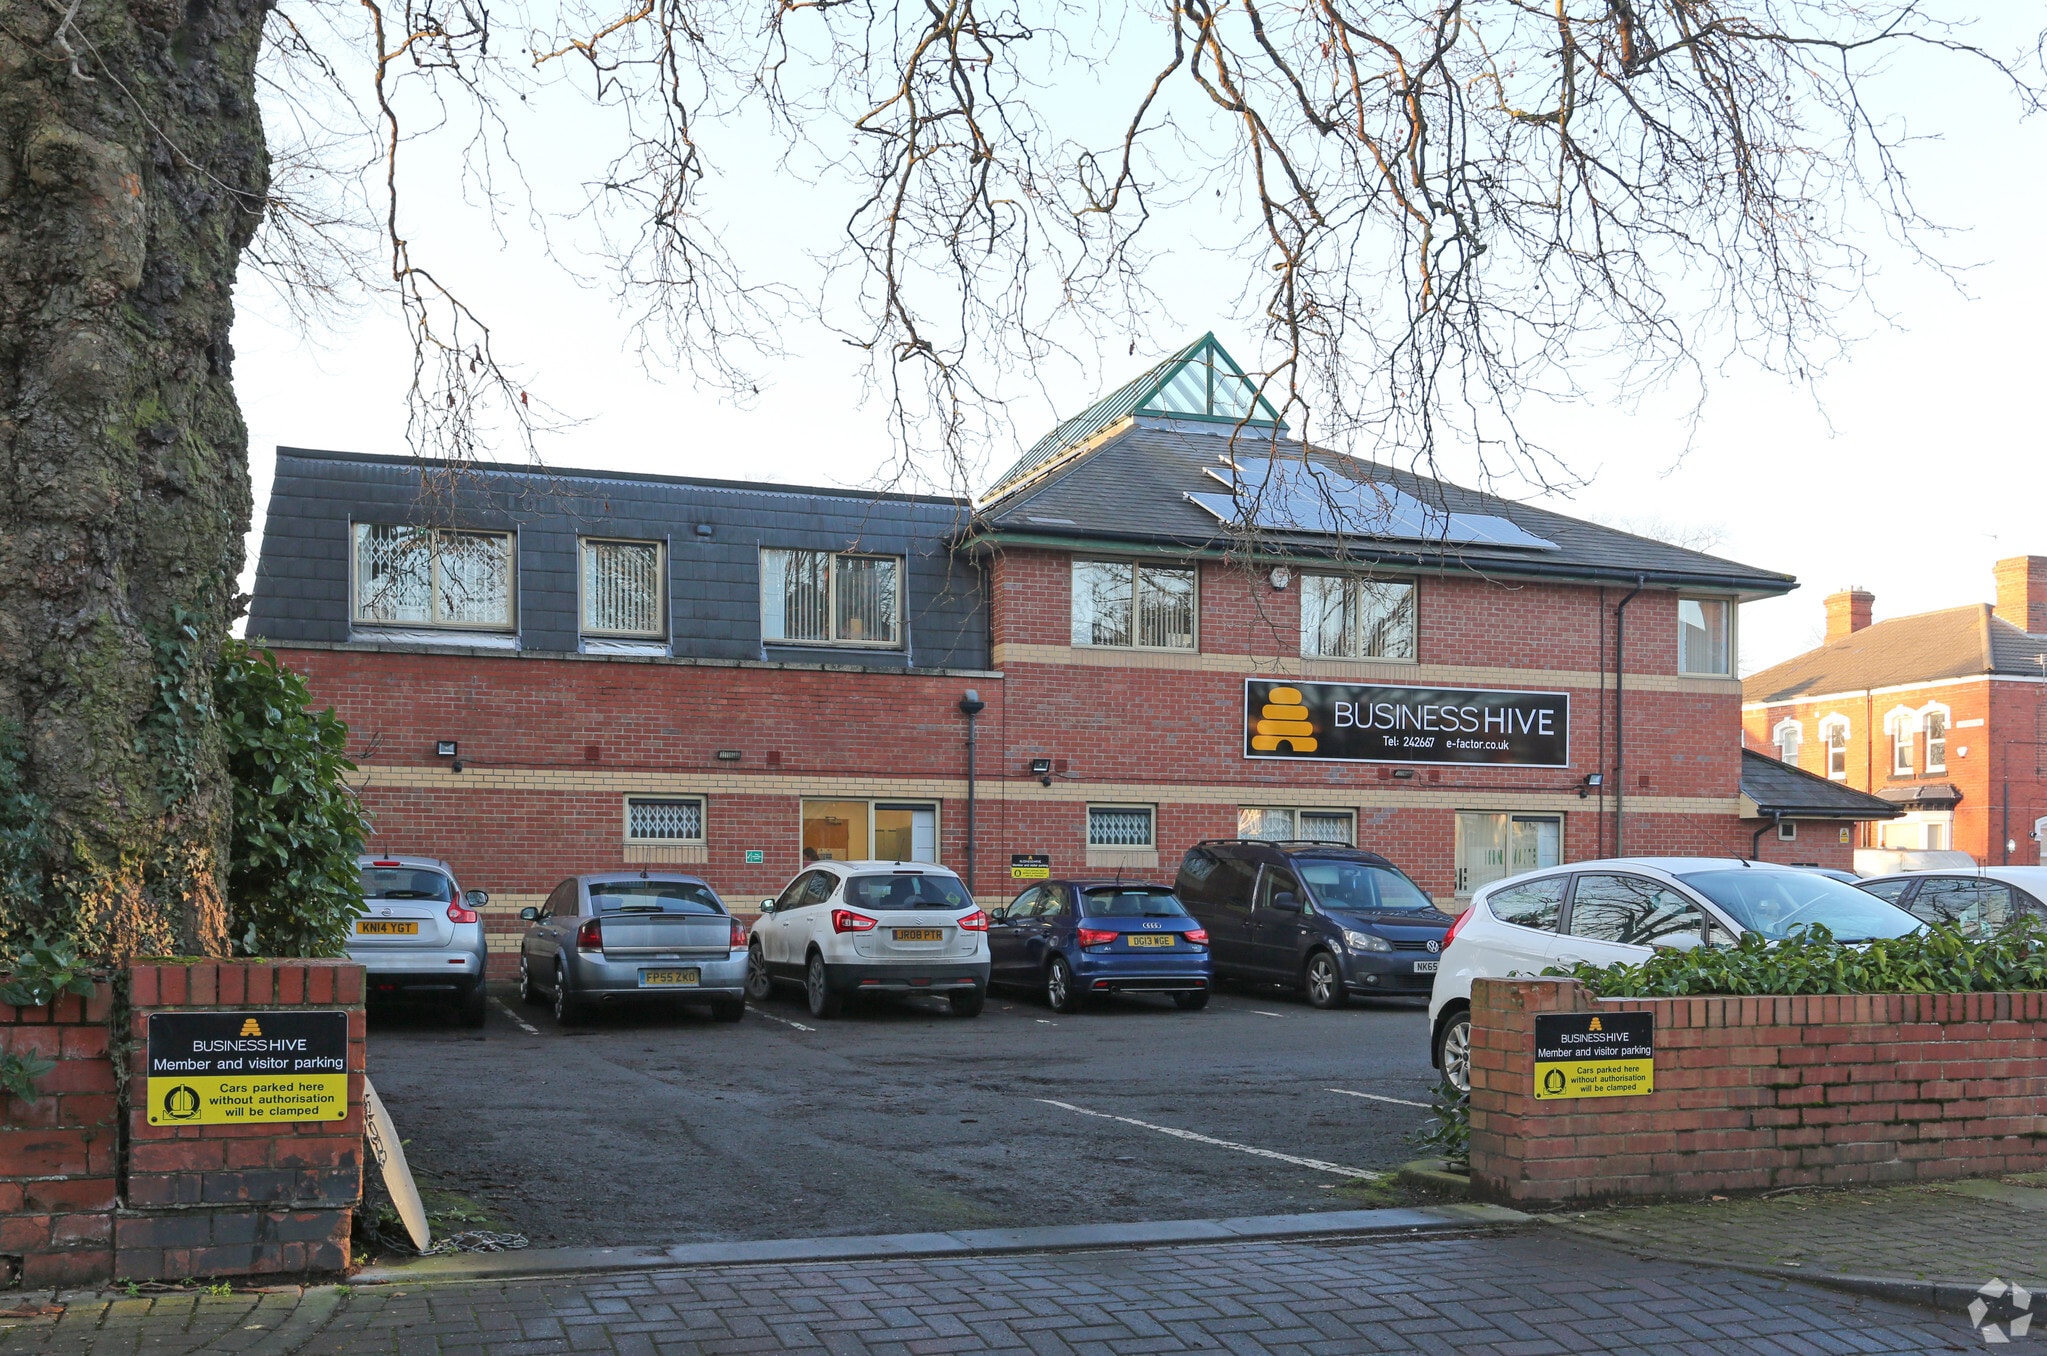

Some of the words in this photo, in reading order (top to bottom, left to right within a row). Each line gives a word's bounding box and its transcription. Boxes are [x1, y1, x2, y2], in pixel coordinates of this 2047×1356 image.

[1382, 735, 1400, 747] Tel:
[1403, 736, 1435, 748] 242667
[1446, 738, 1509, 750] e-factor.co.uk
[362, 923, 387, 933] KN14
[391, 923, 412, 933] YGT
[924, 929, 943, 940] PTR
[1133, 936, 1152, 946] DG13
[646, 972, 674, 982] FP55
[1538, 1047, 1573, 1058] Member
[1575, 1046, 1591, 1057] and
[1594, 1046, 1619, 1056] visitor
[1621, 1044, 1651, 1057] parking
[154, 1058, 212, 1071] Member
[217, 1057, 243, 1070] and
[248, 1056, 290, 1069] visitor
[294, 1055, 344, 1072] parking
[1576, 1066, 1594, 1075] Cars
[1596, 1065, 1622, 1076] parked
[1624, 1065, 1640, 1073] here
[1570, 1075, 1598, 1084] without
[1599, 1073, 1647, 1083] authorisation
[219, 1083, 248, 1093] Cars
[252, 1082, 294, 1094] parked
[298, 1082, 325, 1092] here
[1580, 1084, 1592, 1093] will
[1594, 1083, 1605, 1092] be
[1606, 1082, 1637, 1093] clamped
[209, 1095, 254, 1105] without
[258, 1093, 335, 1104] authorisation
[225, 1107, 244, 1117] will
[249, 1106, 264, 1117] be
[269, 1105, 319, 1118] clamped
